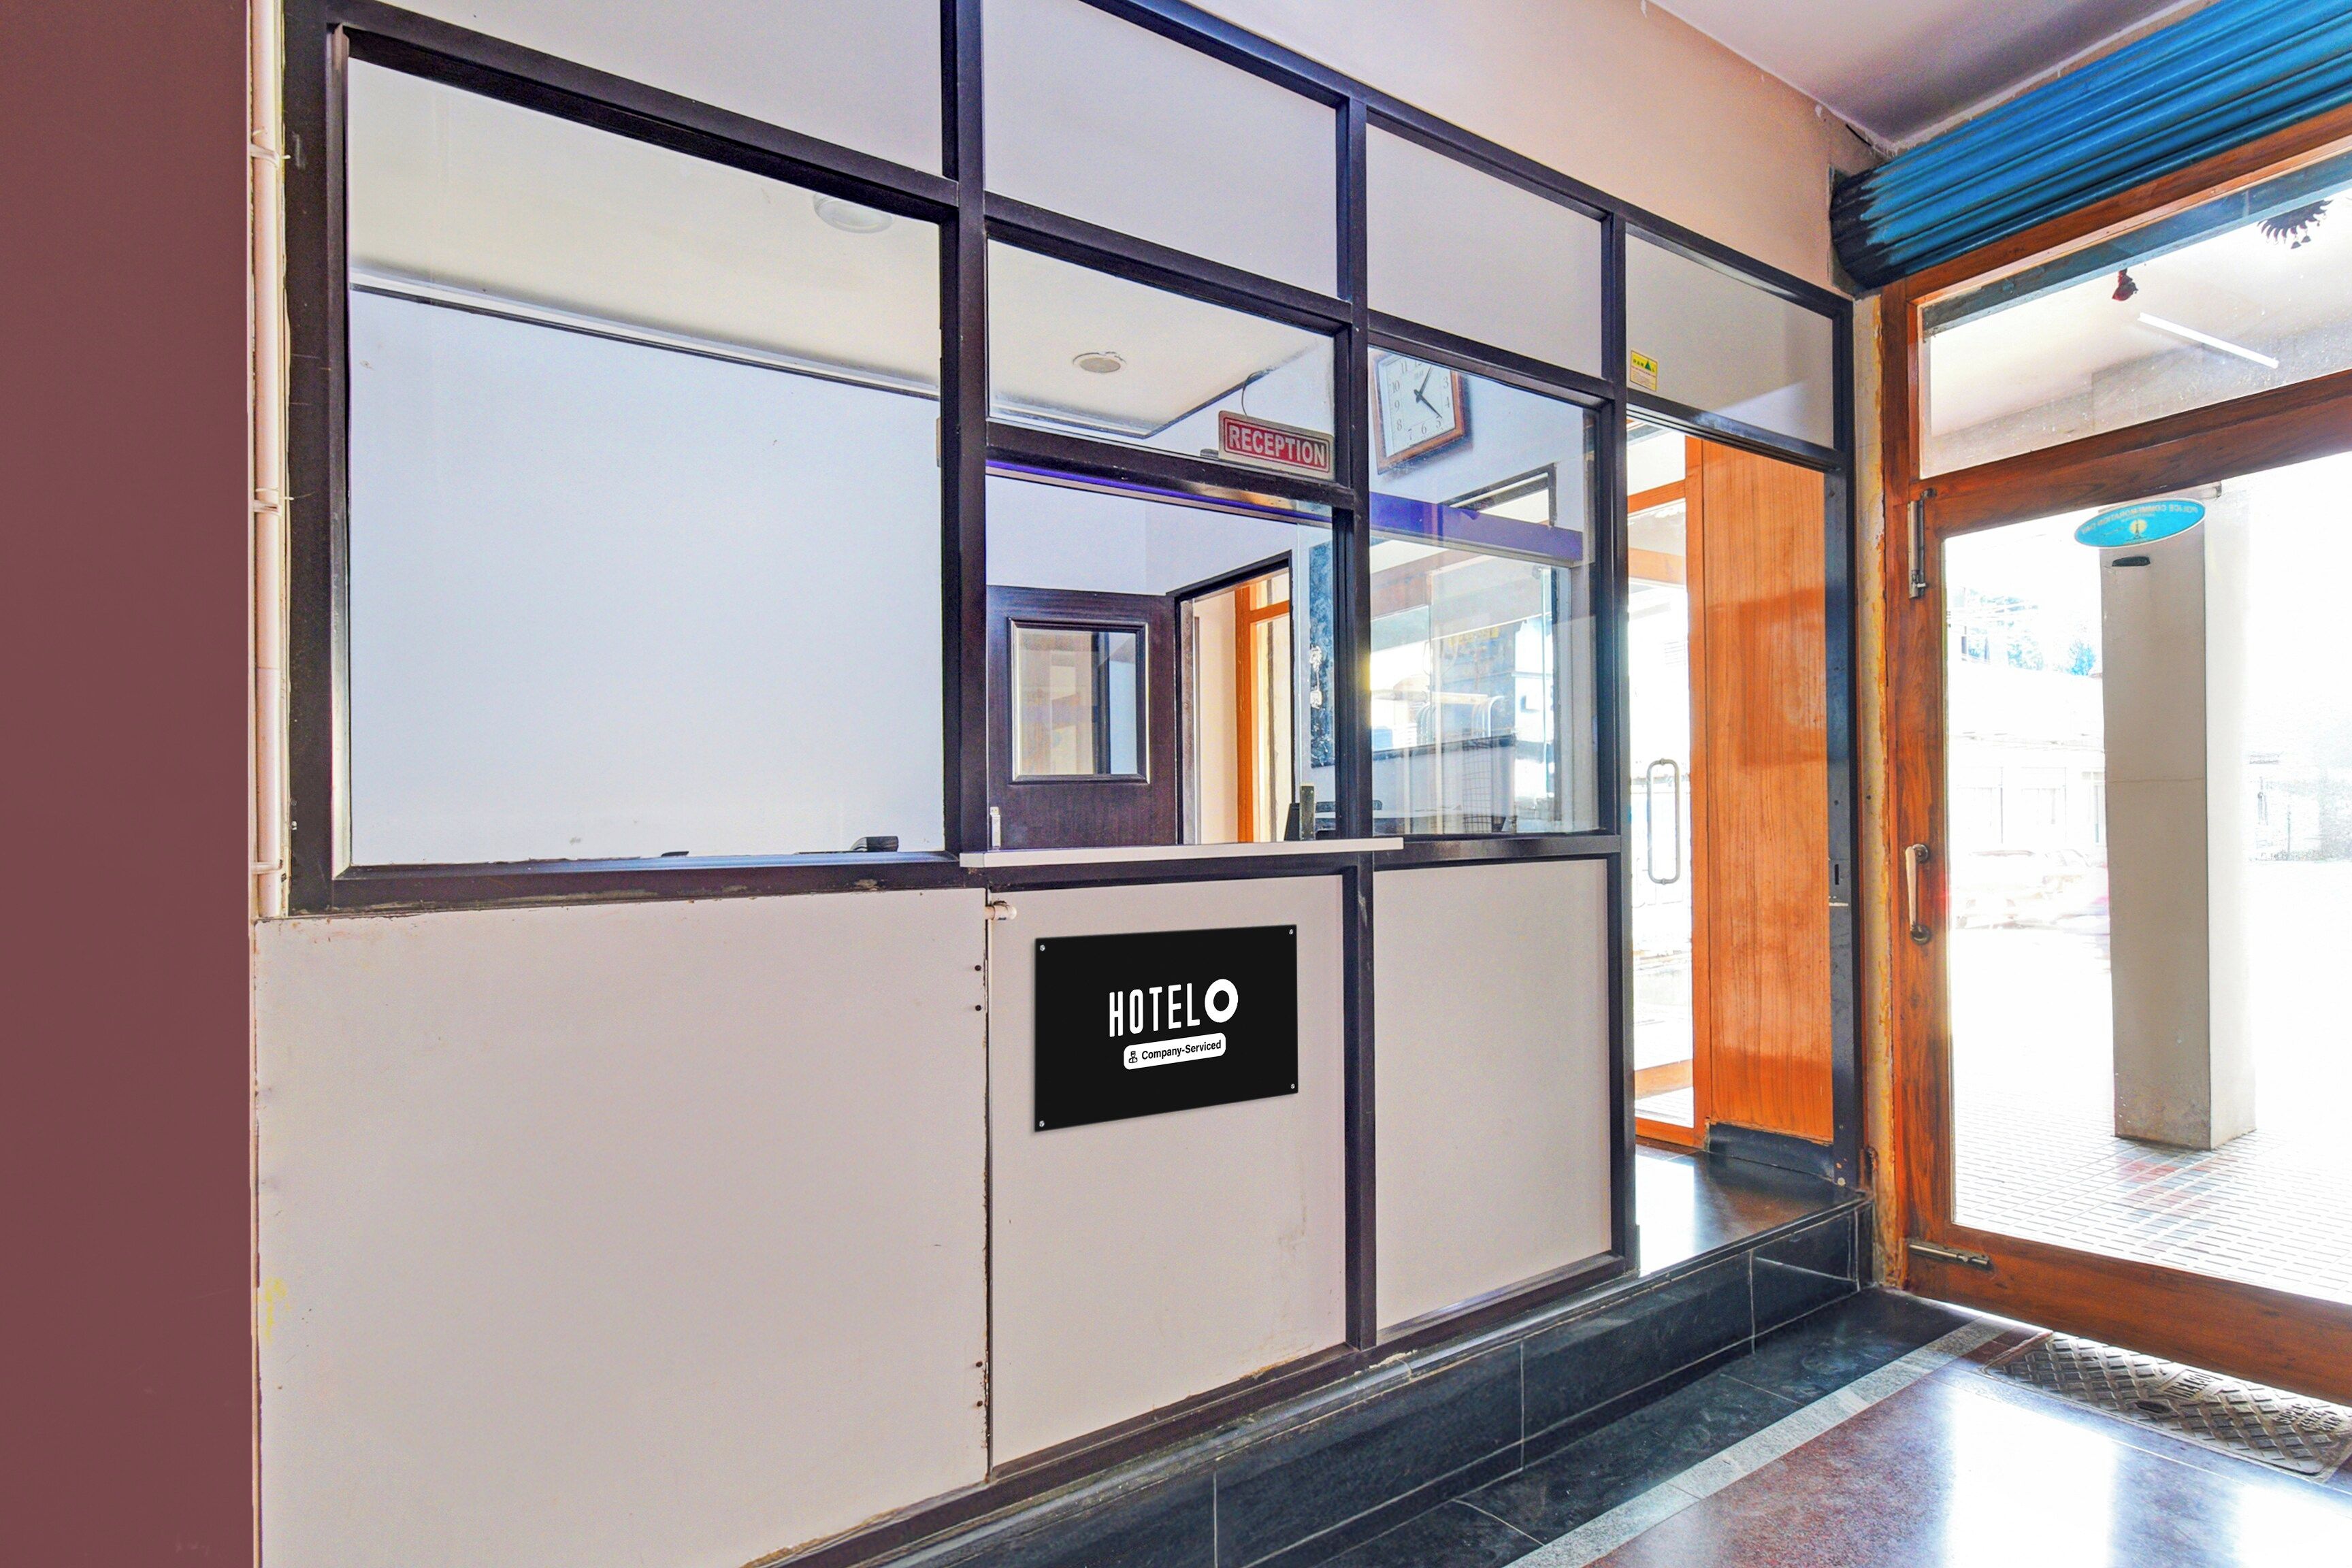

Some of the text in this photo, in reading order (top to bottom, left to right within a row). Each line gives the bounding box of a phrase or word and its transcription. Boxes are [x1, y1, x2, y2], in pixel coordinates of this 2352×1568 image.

[1401, 360, 1408, 374] 11
[1392, 380, 1400, 393] 10
[1443, 376, 1449, 389] 3
[1394, 400, 1400, 412] 9
[1445, 396, 1450, 408] 4
[1396, 419, 1403, 431] 8
[1436, 416, 1441, 428] 5
[1408, 429, 1412, 440] 7
[1421, 423, 1427, 434] 6
[1229, 425, 1325, 466] RECEPTION
[1109, 983, 1200, 1037] HOTEL
[1142, 1039, 1222, 1060] Company-Serviced
